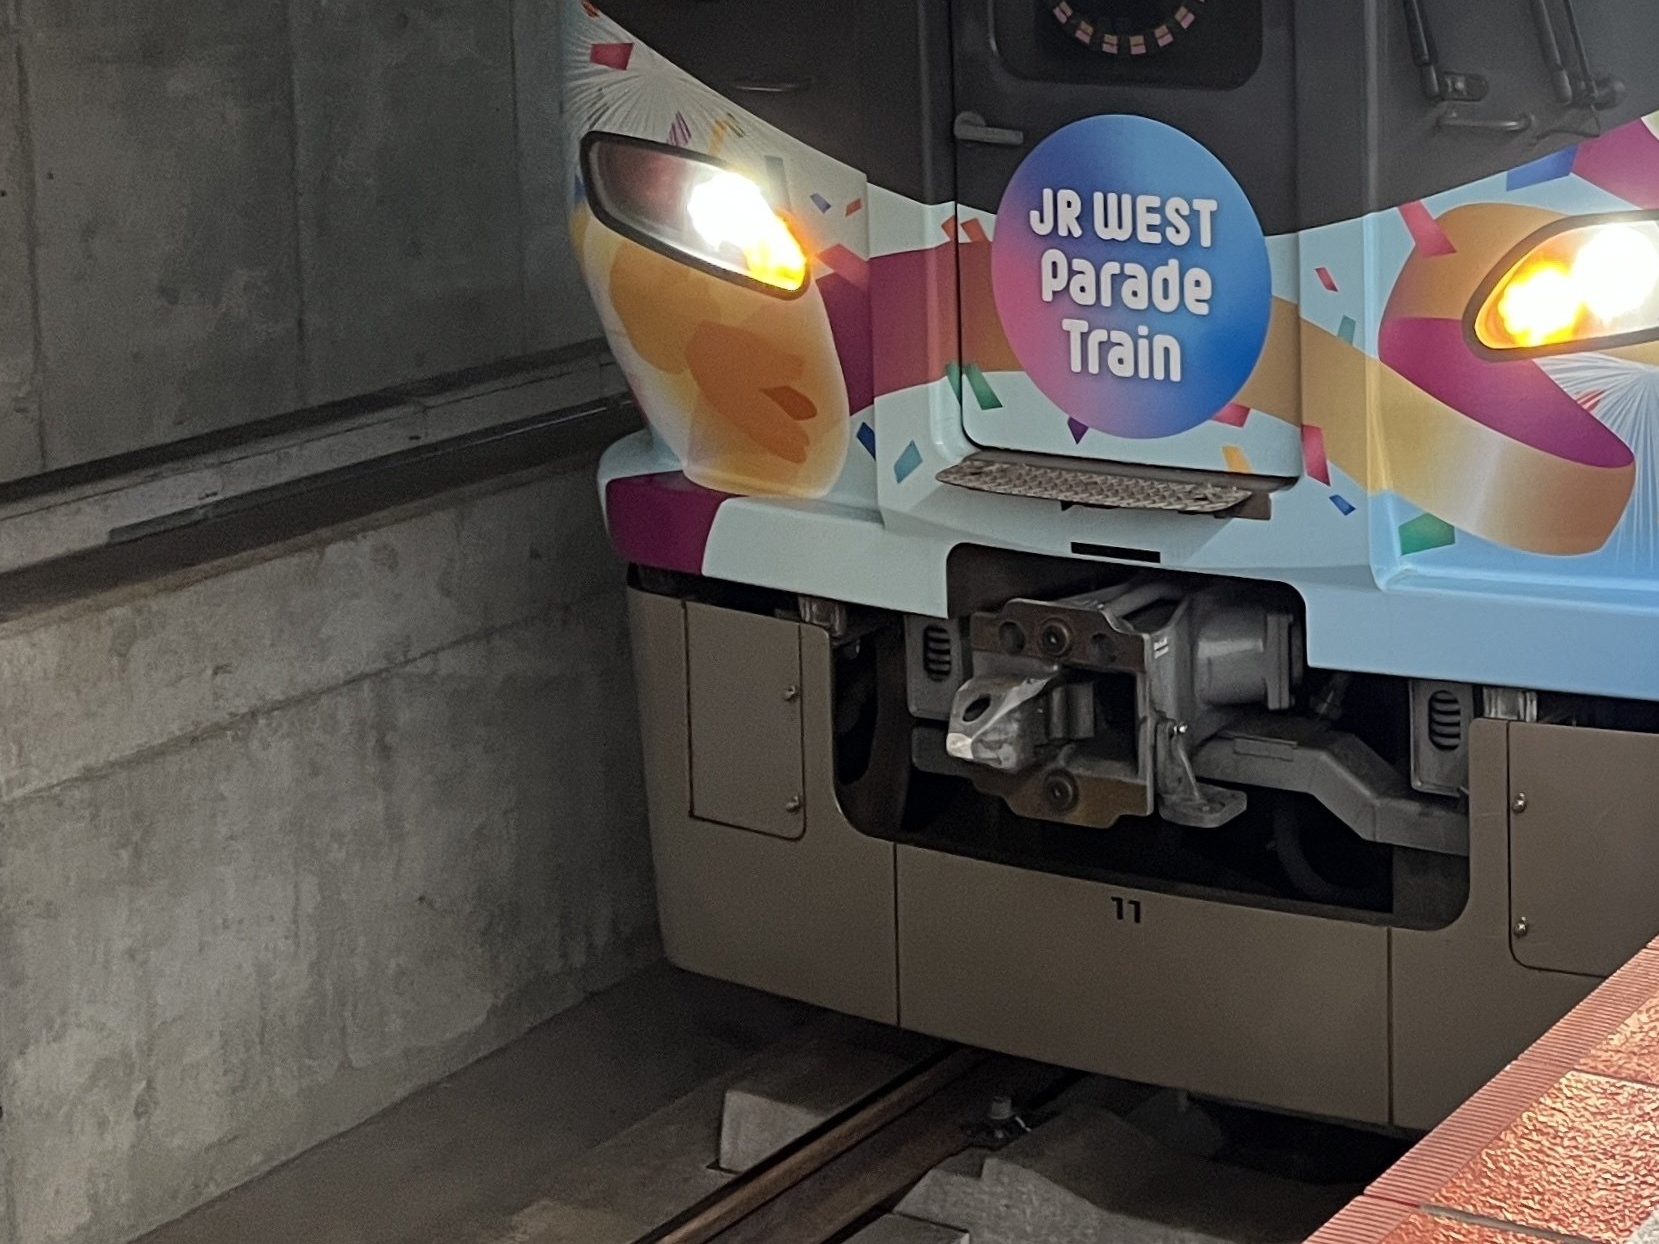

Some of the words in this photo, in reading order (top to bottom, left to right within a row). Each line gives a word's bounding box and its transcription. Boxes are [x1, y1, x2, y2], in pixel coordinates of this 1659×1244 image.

[1029, 187, 1083, 239] JR
[1092, 190, 1219, 248] WEST
[1040, 248, 1213, 316] Parade
[1061, 318, 1182, 383] Train
[1110, 896, 1142, 924] 11
